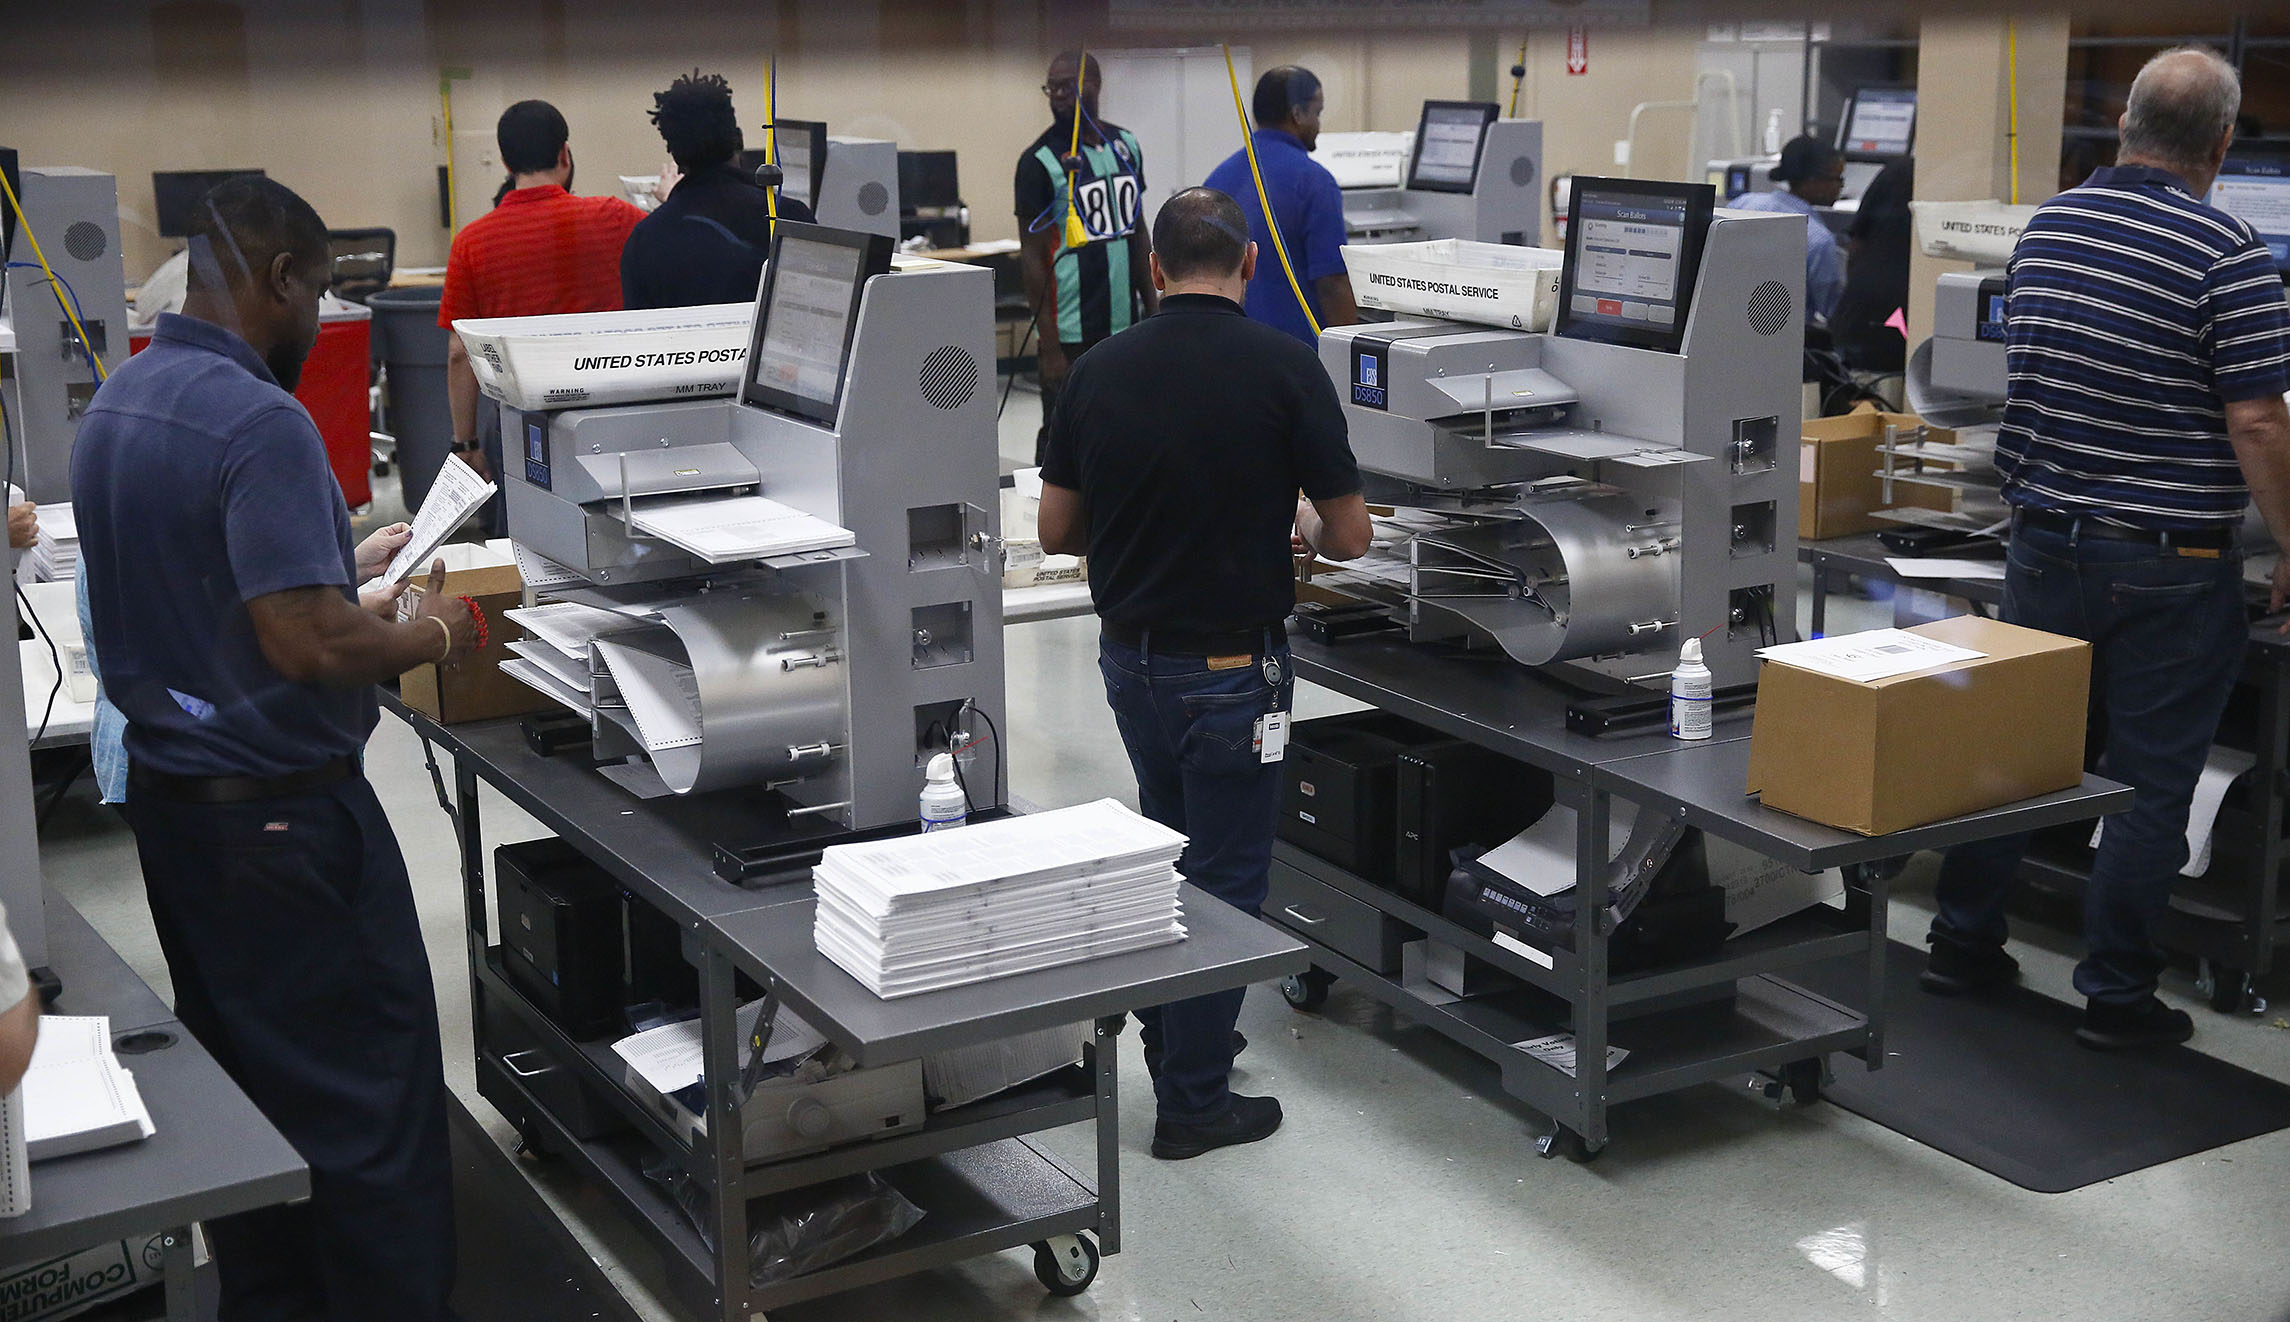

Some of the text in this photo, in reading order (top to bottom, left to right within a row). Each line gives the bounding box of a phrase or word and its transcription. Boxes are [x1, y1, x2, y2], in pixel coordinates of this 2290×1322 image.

[1087, 181, 1135, 236] 80
[1616, 209, 1630, 219] Scan
[1941, 220, 1972, 233] UNITED
[1975, 224, 2006, 237] STATES
[1369, 272, 1499, 300] UNITED STATES POSTAL SERVICE
[573, 355, 632, 371] UNITED
[634, 352, 695, 368] STATES
[550, 387, 584, 395] WARNING
[675, 382, 726, 394] MM TRAY
[1355, 387, 1383, 405] DS850
[1405, 831, 1419, 841] APC
